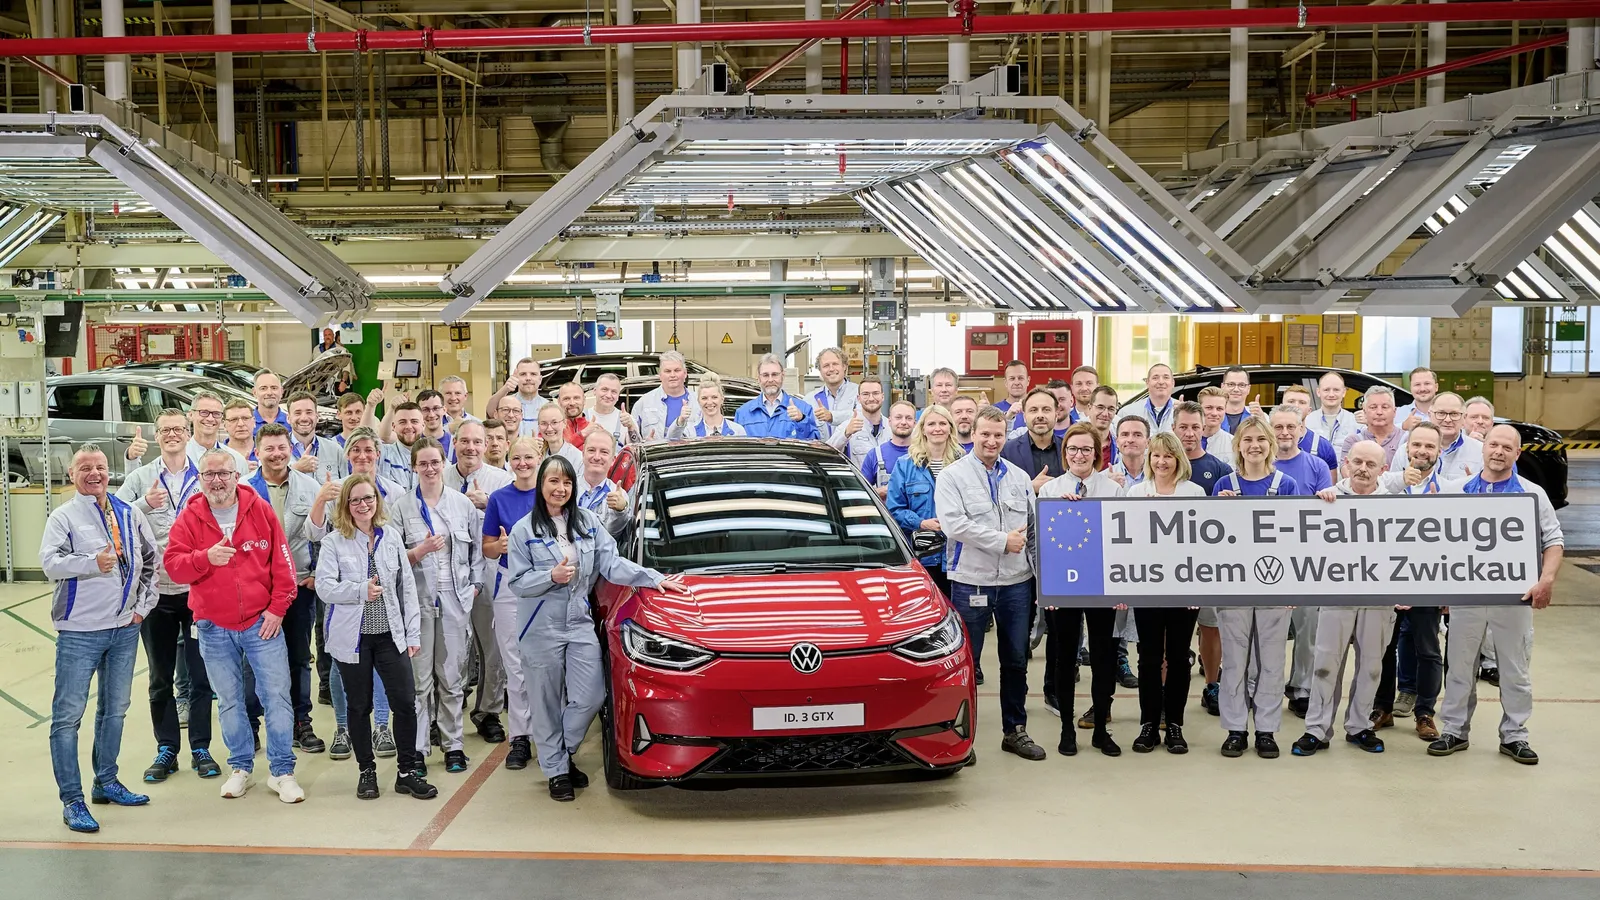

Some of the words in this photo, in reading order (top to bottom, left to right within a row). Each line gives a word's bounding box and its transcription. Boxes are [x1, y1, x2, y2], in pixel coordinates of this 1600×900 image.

[1111, 511, 1133, 544] 1
[1149, 509, 1237, 544] Mio.
[1252, 508, 1525, 552] E-Fahrzeuge
[1067, 569, 1079, 583] D
[1109, 563, 1164, 583] aus
[1174, 556, 1246, 583] dem
[1290, 555, 1380, 582] Werk
[1389, 554, 1527, 582] Zwickau
[784, 713, 799, 723] ID.
[801, 712, 809, 722] 3
[811, 711, 834, 721] GTX
